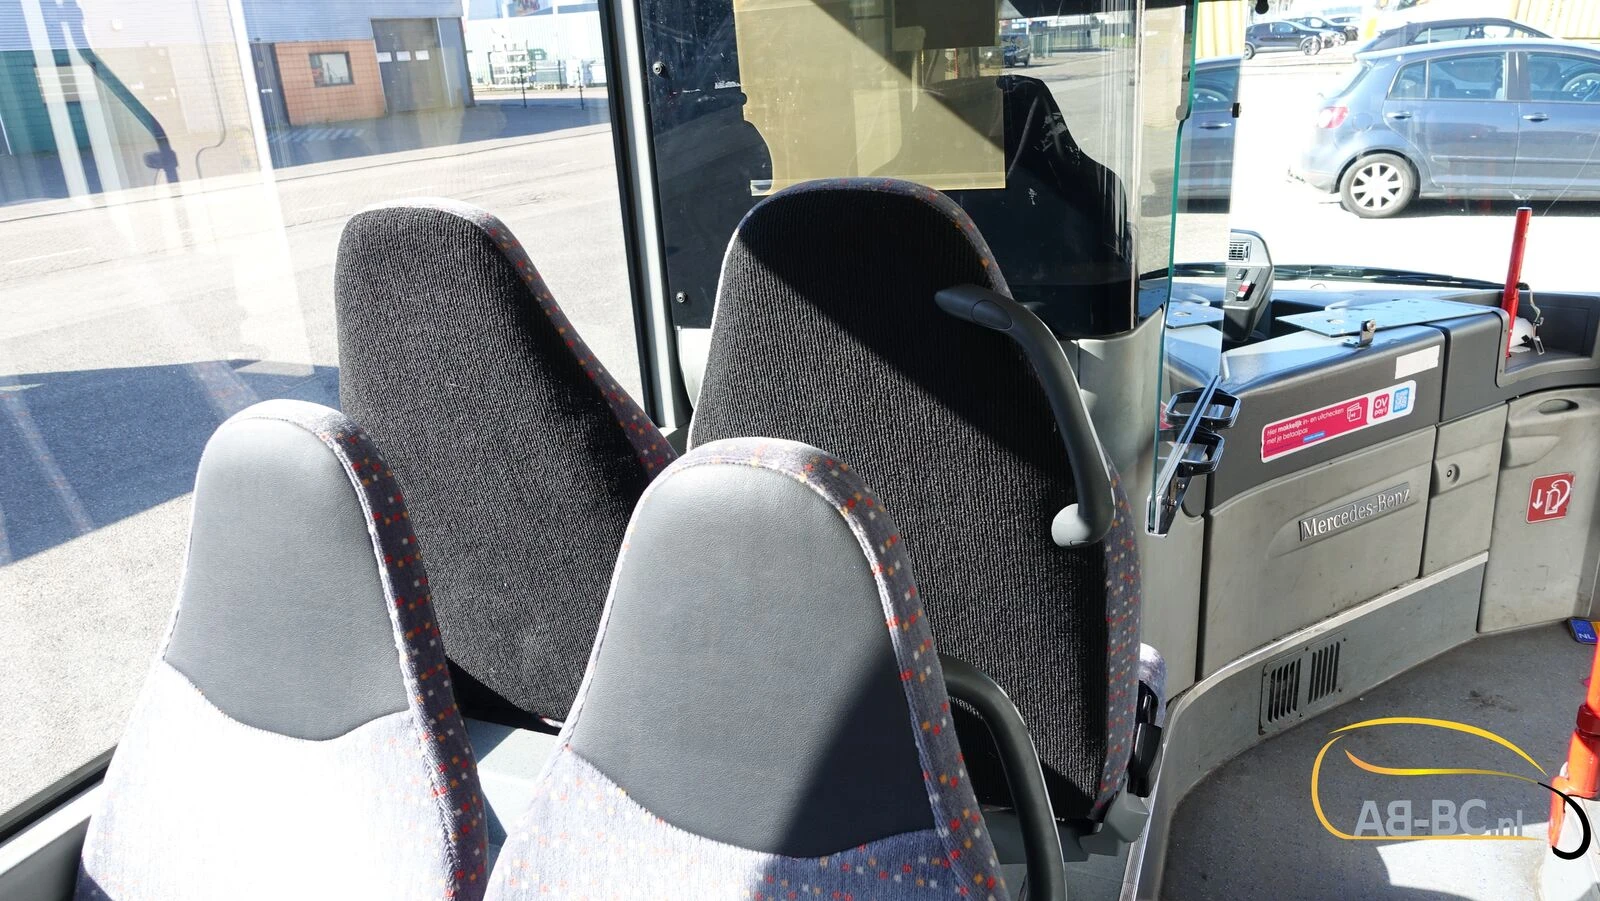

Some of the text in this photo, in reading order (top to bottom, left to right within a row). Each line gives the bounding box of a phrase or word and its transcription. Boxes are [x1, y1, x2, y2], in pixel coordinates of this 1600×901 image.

[1375, 396, 1388, 409] OV
[1267, 427, 1278, 436] Hier
[1278, 420, 1303, 432] makkelijk
[1317, 408, 1345, 421] uitchecken
[1266, 437, 1277, 445] met
[1283, 427, 1309, 440] betaalpas
[1302, 488, 1410, 540] Mercedes-Benz
